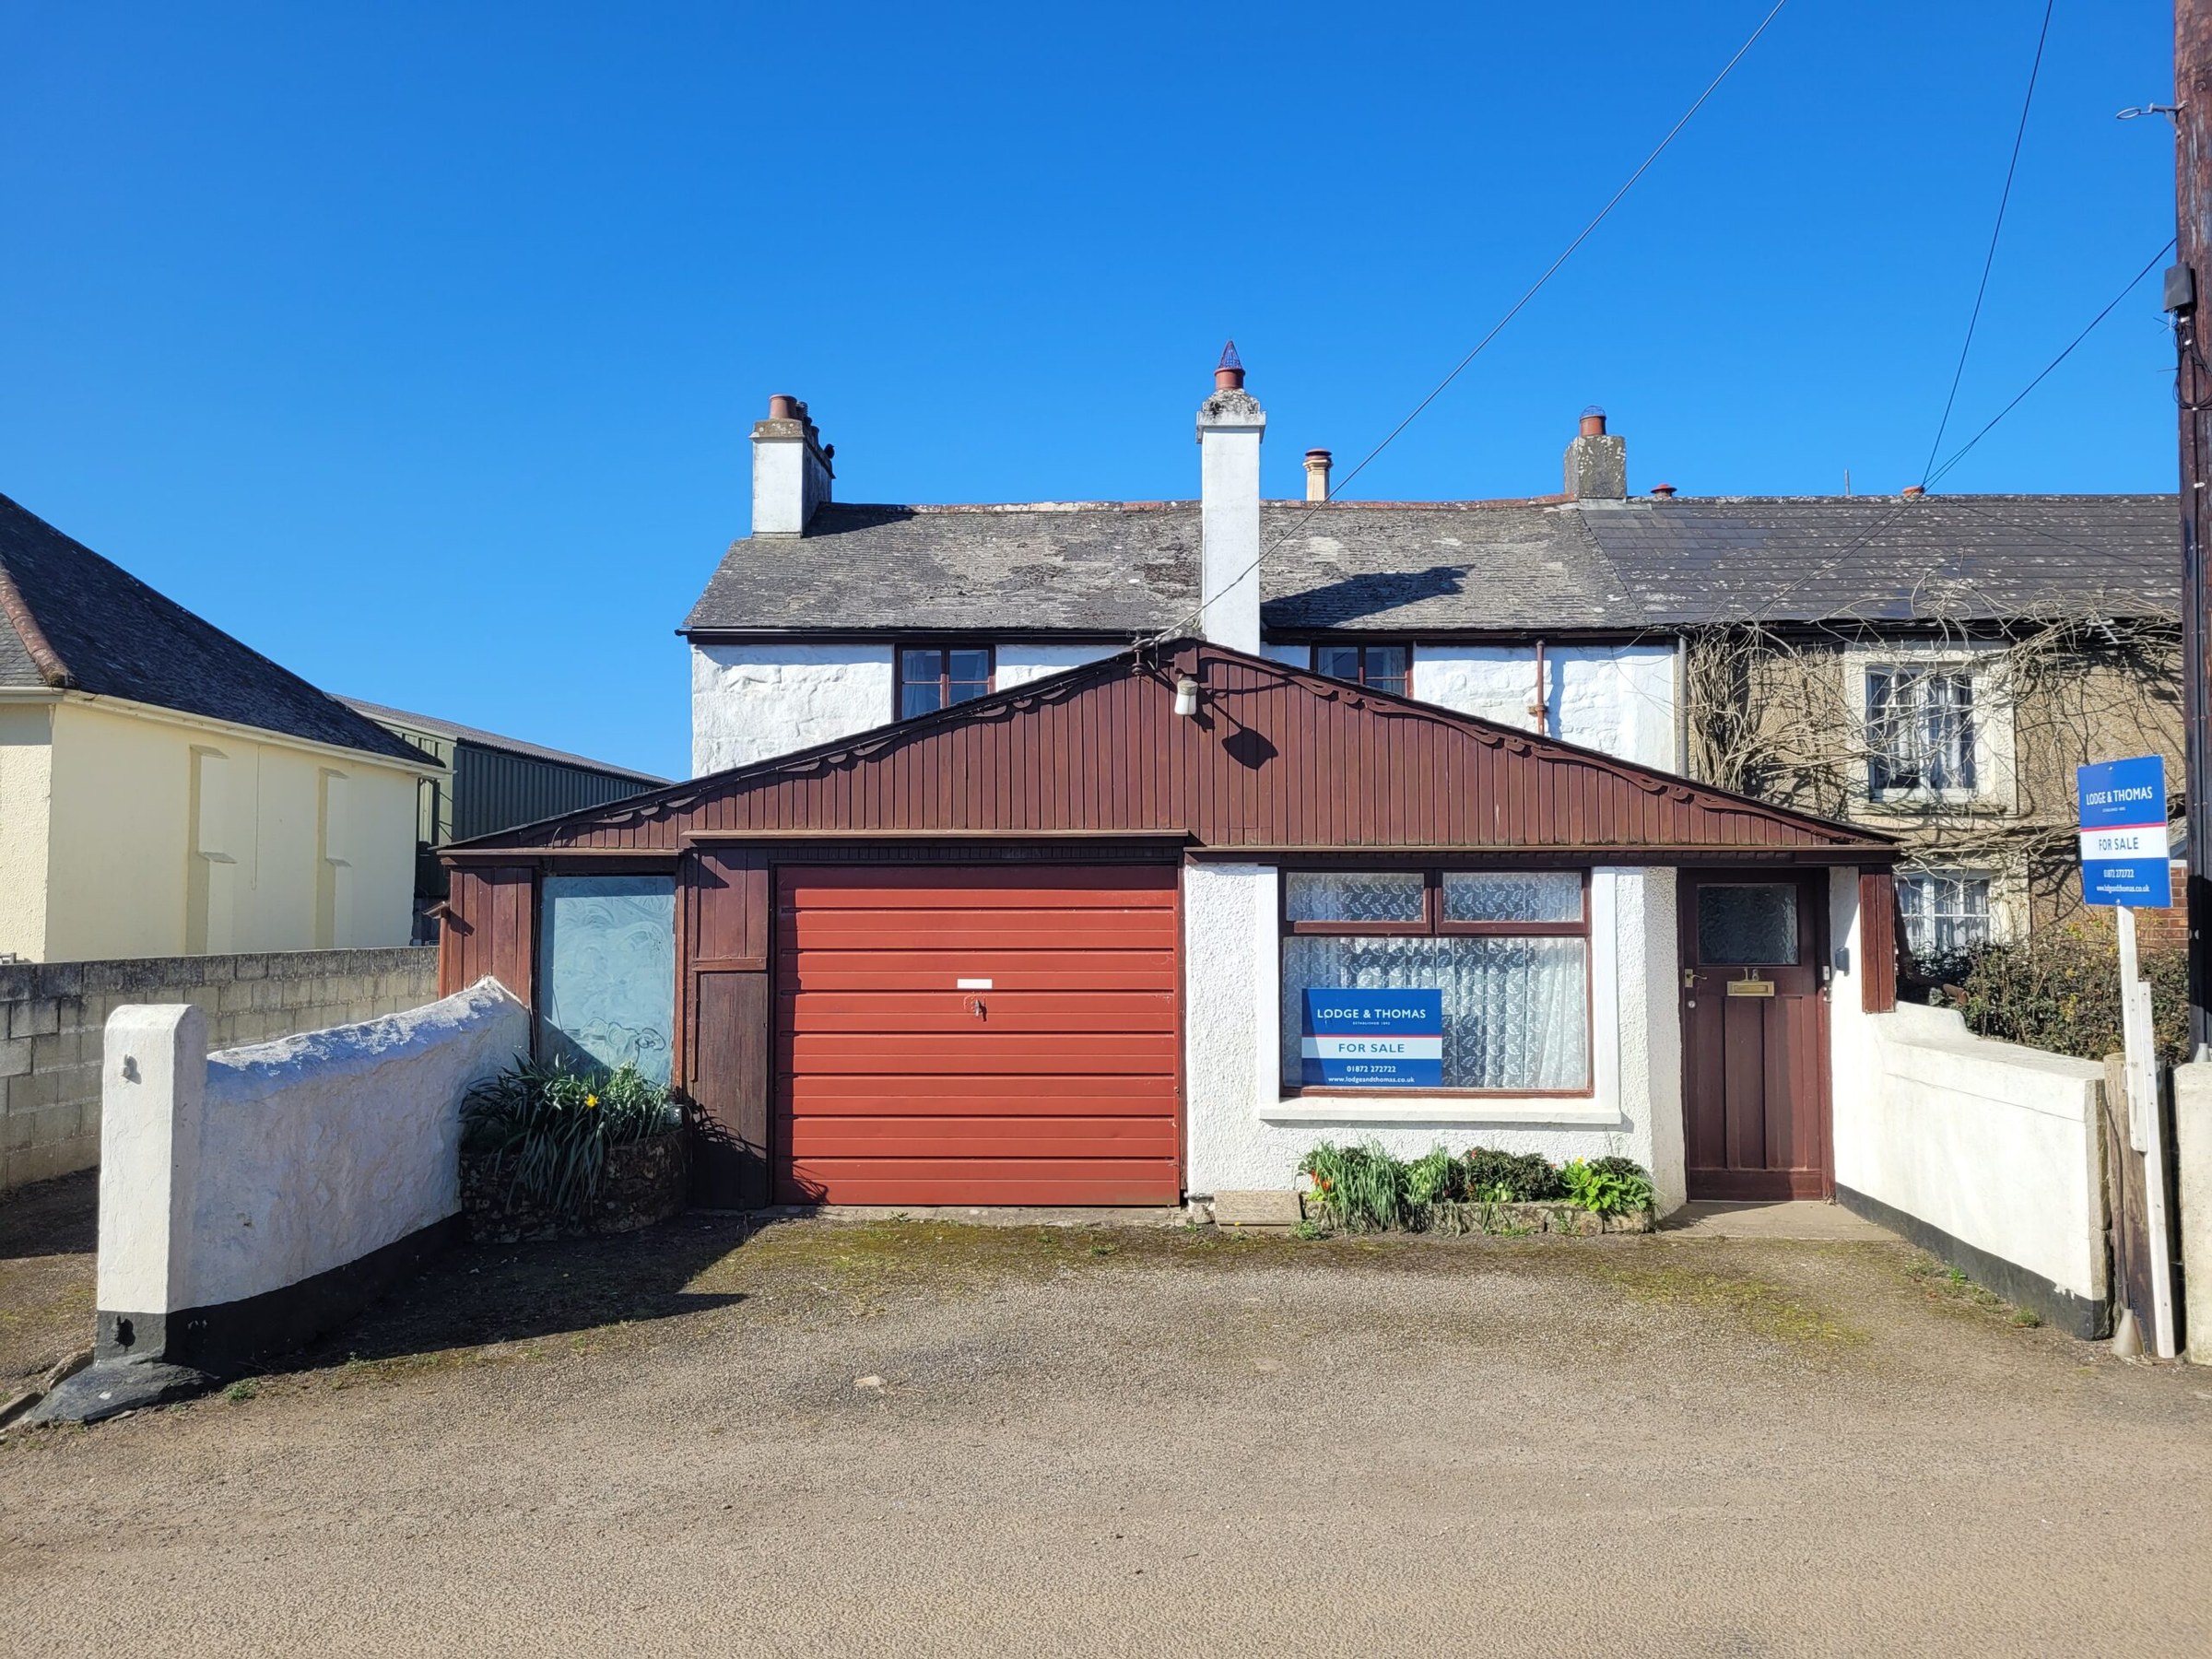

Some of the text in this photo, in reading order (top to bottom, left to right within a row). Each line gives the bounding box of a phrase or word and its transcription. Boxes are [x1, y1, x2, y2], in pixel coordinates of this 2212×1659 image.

[2086, 786, 2153, 806] LODGE & THOMAS
[2099, 837, 2139, 851] FOR SALE
[1743, 967, 1759, 981] 18
[1317, 1008, 1427, 1019] LODGE & THOMAS
[1338, 1043, 1405, 1053] FOR SALE
[1327, 1076, 1416, 1084] www.lodgeandthomas.co.uk
